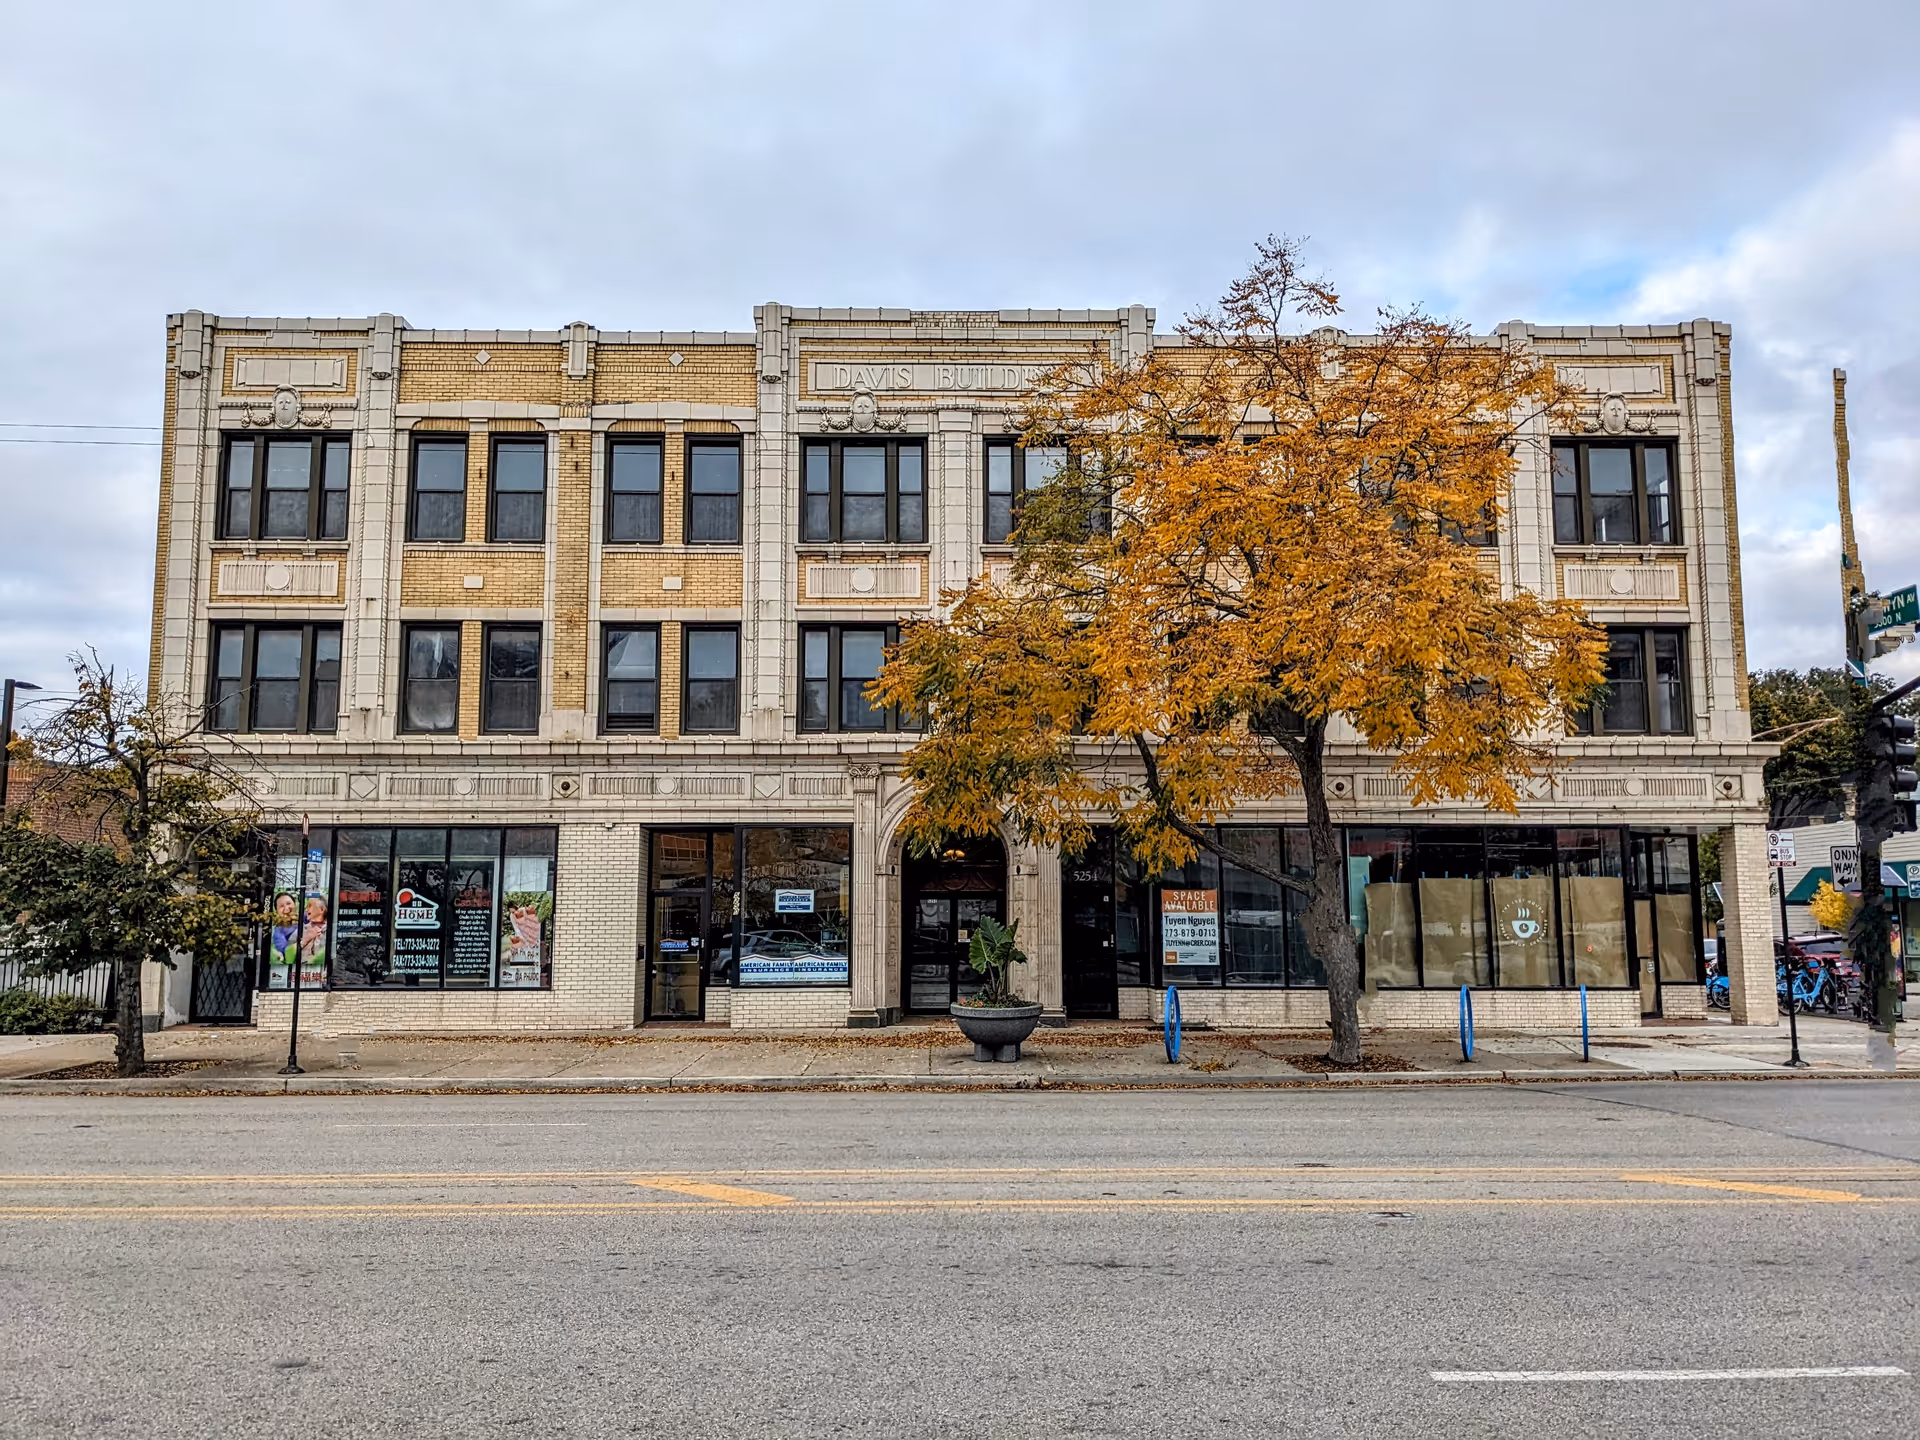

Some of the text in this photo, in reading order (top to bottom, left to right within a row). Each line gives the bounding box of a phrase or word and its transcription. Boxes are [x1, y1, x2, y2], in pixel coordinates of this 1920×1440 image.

[834, 367, 1055, 390] DAVIS BUILDI
[1906, 592, 1915, 604] AV
[1895, 612, 1902, 622] N
[1074, 870, 1098, 882] 5254
[1173, 891, 1206, 901] SPACE
[1164, 900, 1215, 911] AVAILABLE
[397, 908, 434, 920] HOME
[1164, 915, 1216, 927] Tuyen Nguyen
[1164, 928, 1217, 938] 773-879-0713
[394, 938, 440, 950] TEL:773-334-3272
